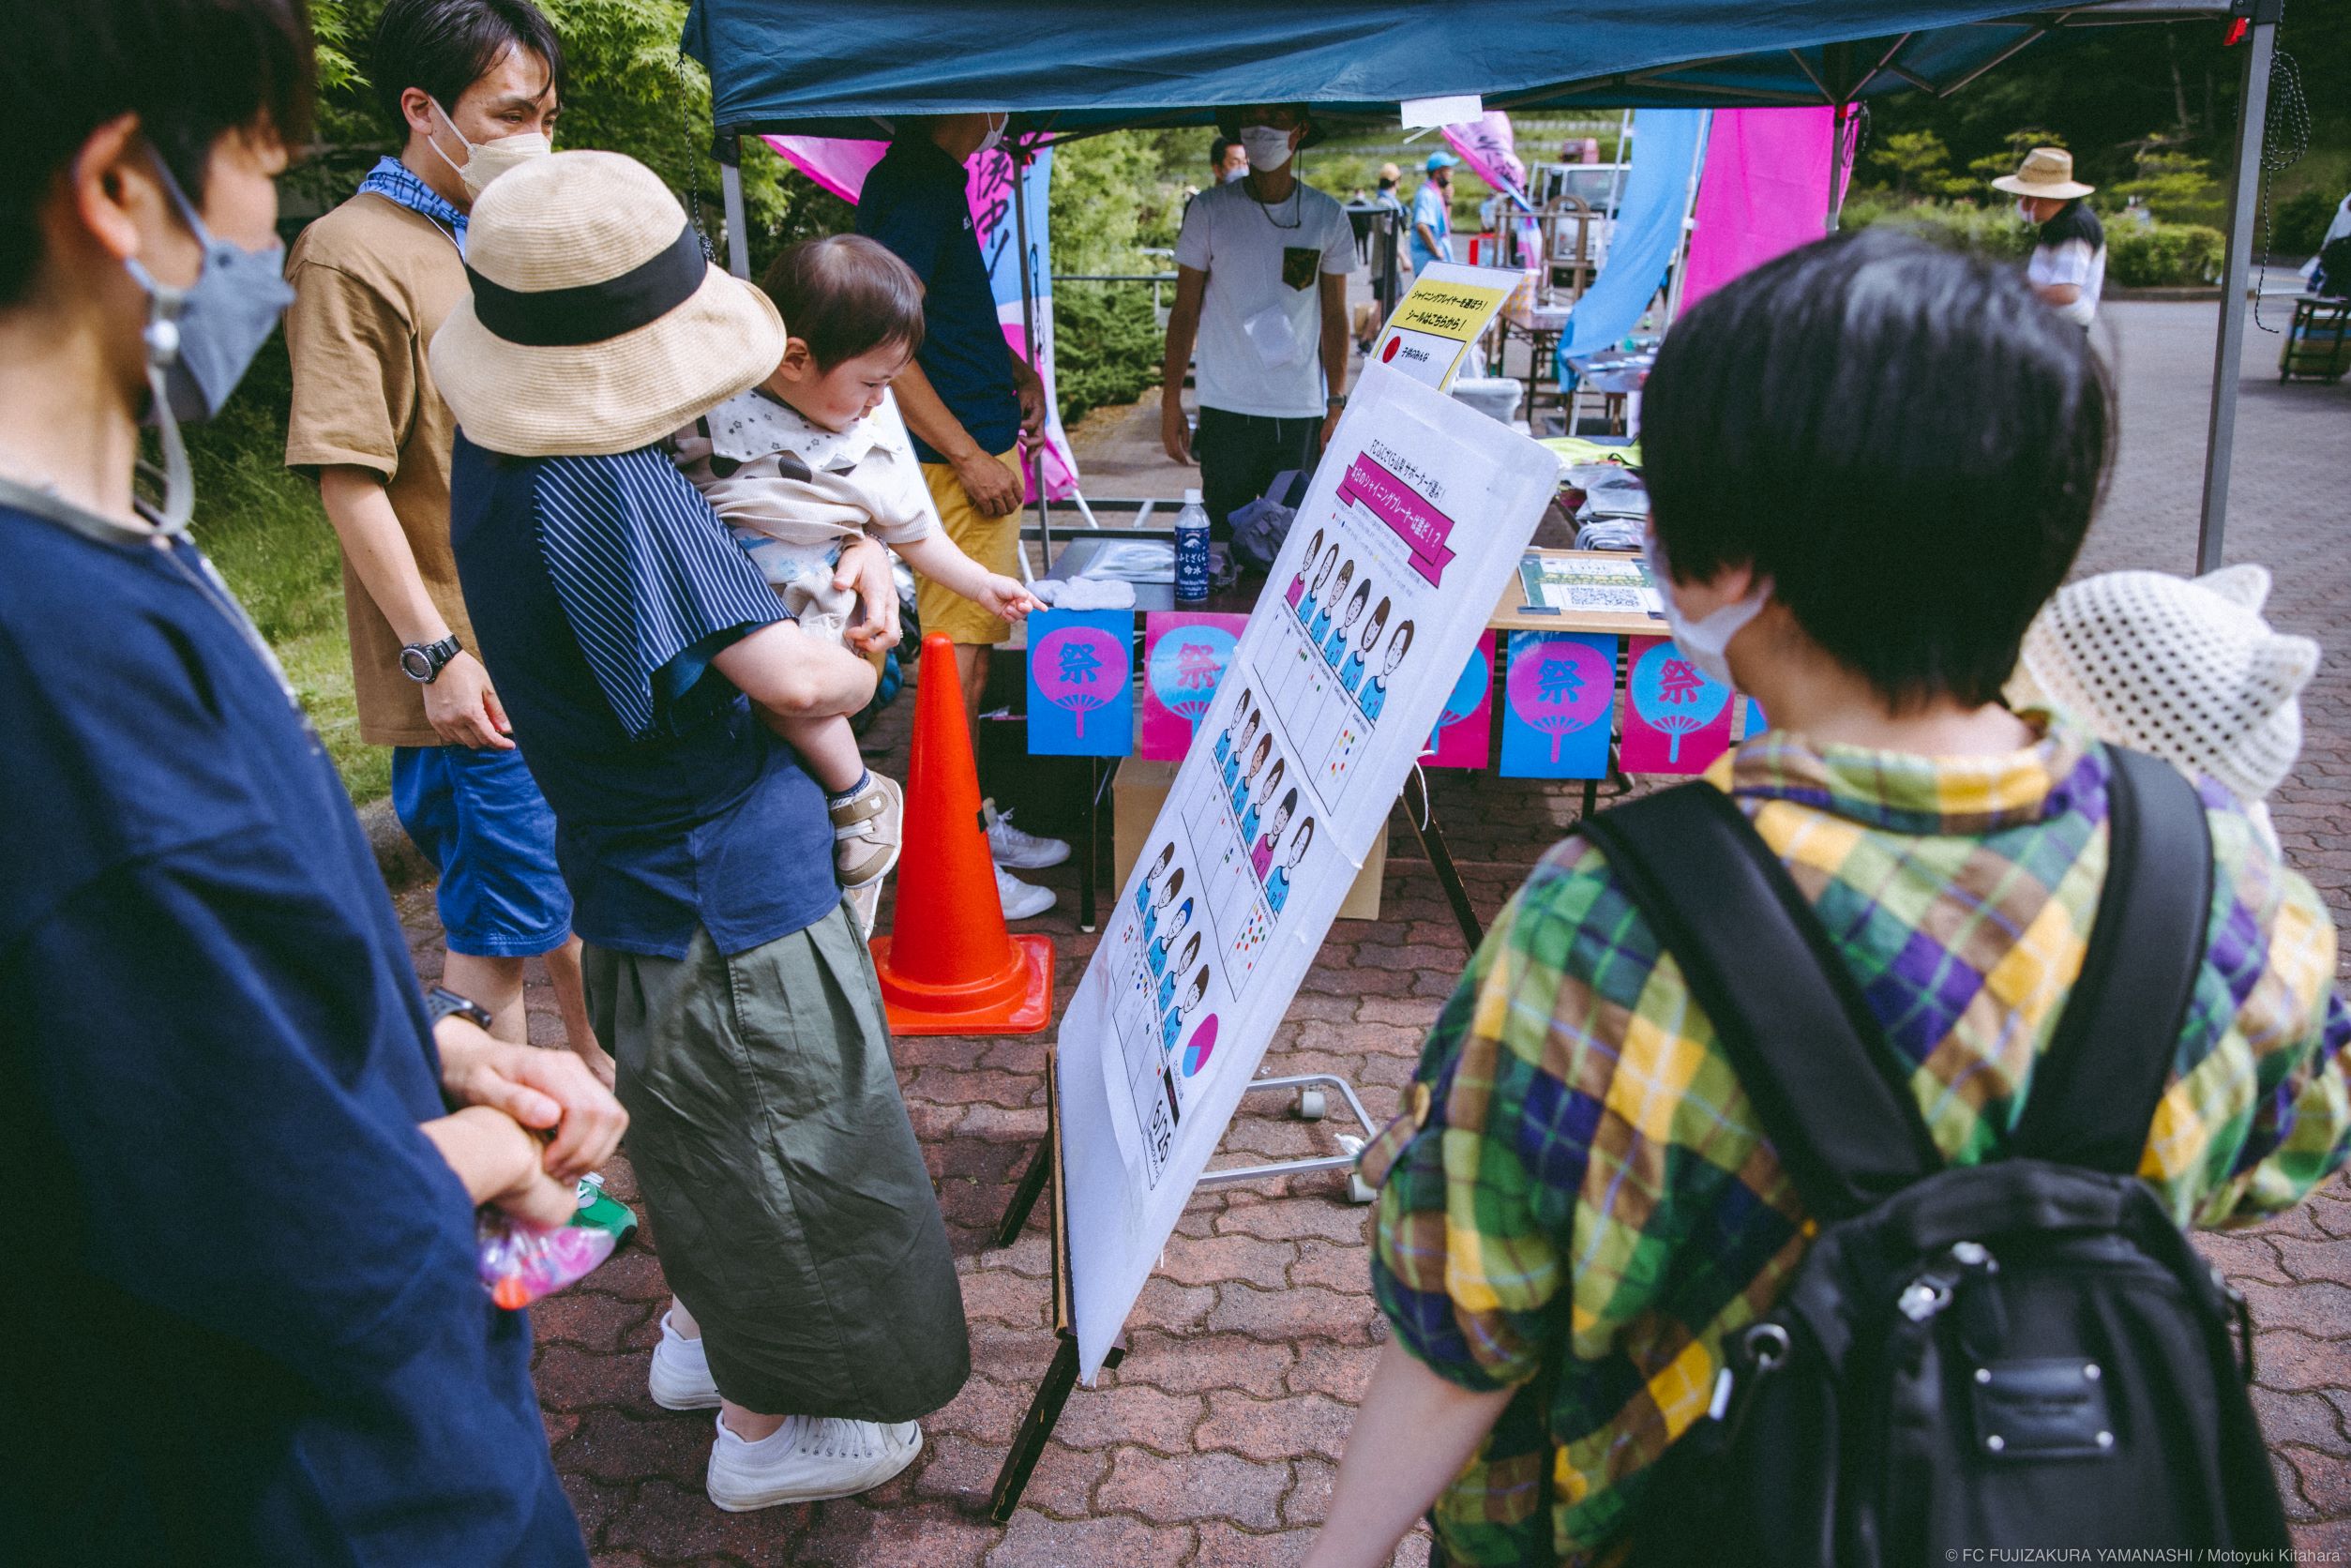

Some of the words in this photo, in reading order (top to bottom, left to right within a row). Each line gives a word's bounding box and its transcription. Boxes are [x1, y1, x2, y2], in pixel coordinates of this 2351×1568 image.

[1406, 309, 1467, 331] シールはこちらから！
[1401, 346, 1430, 363] 子供のみんな
[1179, 552, 1206, 563] ふじざくら
[1058, 642, 1103, 684] 祭
[1177, 642, 1222, 689] 祭
[1536, 658, 1585, 704] 祭
[1658, 657, 1705, 704] 祭
[1153, 1099, 1171, 1163] 6/26
